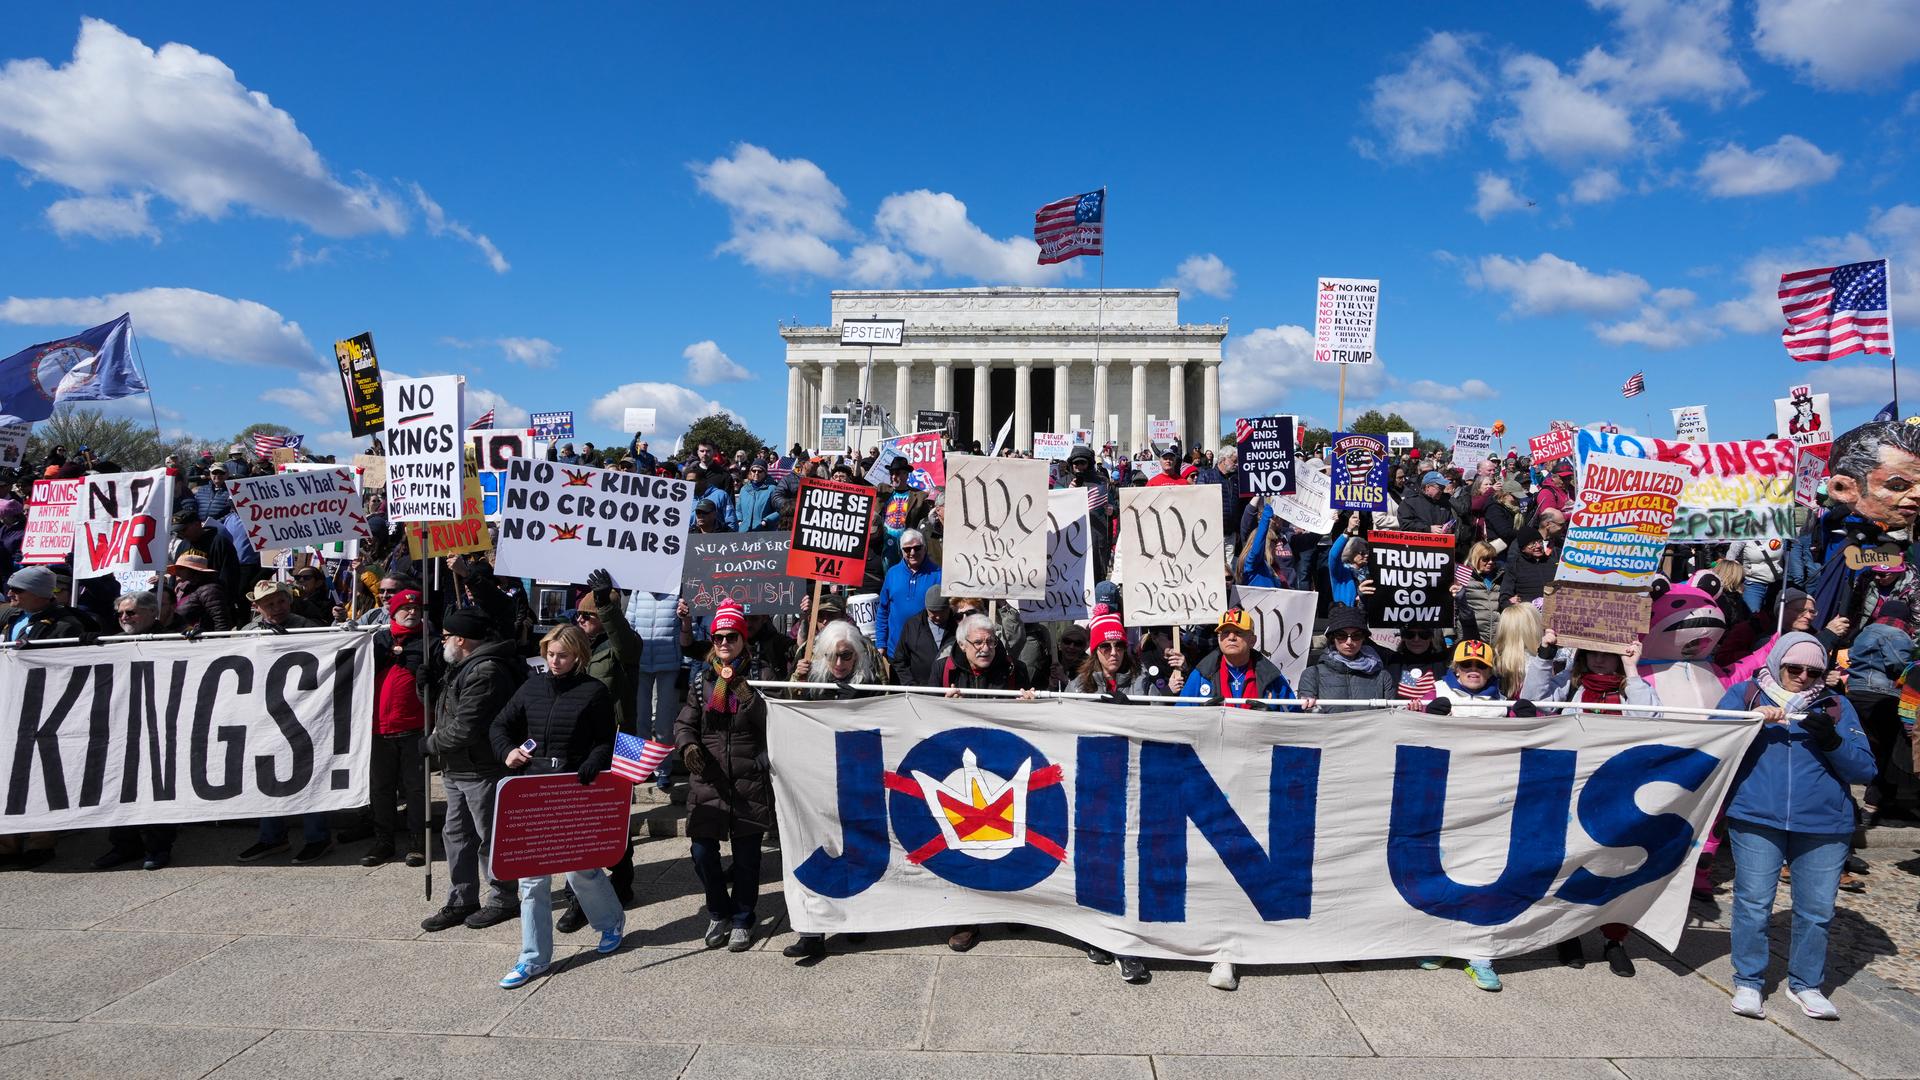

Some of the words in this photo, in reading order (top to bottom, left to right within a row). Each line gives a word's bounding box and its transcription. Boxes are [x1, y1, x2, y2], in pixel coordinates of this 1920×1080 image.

[1339, 284, 1353, 292] NO
[1354, 285, 1377, 293] KING
[1336, 294, 1375, 302] DICTATOR
[1336, 302, 1375, 310] TYRANT
[1335, 310, 1374, 318] FASCIST
[1335, 318, 1374, 326] RACIST
[843, 326, 901, 340] EPSTEIN?
[1316, 350, 1331, 362] NO
[1332, 350, 1372, 363] TRUMP
[399, 384, 434, 413] NO
[533, 415, 571, 425] RESIST!
[1262, 419, 1278, 428] ALL
[1253, 430, 1277, 439] ENDS
[1459, 426, 1471, 434] HEY
[1818, 431, 1830, 442] YOU
[388, 424, 454, 456] KINGS
[1251, 441, 1280, 449] WHEN
[1341, 437, 1380, 451] REJECTING
[1532, 432, 1560, 448] TEAR
[1246, 451, 1286, 460] ENOUGH
[1654, 438, 1797, 479] KINGS
[1808, 459, 1818, 470] NO
[390, 464, 405, 479] NO
[406, 462, 456, 481] TRUMP
[1243, 463, 1256, 471] OF
[1258, 462, 1270, 470] US
[1272, 460, 1290, 469] SAY
[247, 482, 280, 501] This
[280, 479, 295, 496] Is
[298, 473, 336, 495] What
[511, 460, 554, 484] NO
[601, 472, 687, 502] KINGS
[809, 480, 866, 493] RefuseFascism.org
[1250, 471, 1286, 492] NO
[1584, 463, 1683, 496] RADICALIZED
[32, 484, 48, 502] NO
[48, 484, 78, 501] KINGS
[89, 477, 154, 520] NO
[392, 483, 406, 499] NO
[410, 482, 451, 499] PUTIN
[1335, 485, 1383, 502] KINGS
[250, 498, 348, 521] Democracy
[389, 501, 401, 517] NO
[403, 501, 456, 518] KHAMENEI
[507, 488, 549, 511] NO
[557, 493, 681, 527] CROOKS
[804, 489, 844, 510] ¡QUE
[847, 495, 869, 514] SE
[950, 463, 1043, 541] We
[1588, 495, 1673, 514] CRITICAL
[39, 506, 70, 517] ANYTIME
[1579, 509, 1672, 527] THINKING
[27, 521, 59, 533] VIOLATORS
[61, 521, 74, 533] WILL
[270, 520, 309, 541] Looks
[313, 517, 343, 536] Like
[800, 508, 866, 534] LARGUE
[1124, 493, 1219, 566] We
[1639, 523, 1662, 533] and
[26, 536, 36, 548] BE
[40, 535, 71, 548] REMOVED
[84, 514, 157, 572] WAR
[412, 517, 482, 551] TRUMP
[503, 518, 545, 541] NO
[587, 526, 680, 555] LIARS
[802, 528, 860, 553] TRUMP
[1374, 532, 1447, 543] RefuseFascism.org
[1567, 529, 1611, 541] NORMAL
[1610, 532, 1667, 545] AMOUNTS
[981, 530, 1017, 562] the
[1594, 543, 1655, 557] HUMAN
[715, 559, 777, 573] LOADING
[815, 556, 844, 576] YA!
[1372, 548, 1449, 569] TRUMP
[1565, 550, 1656, 570] COMPASSION
[1855, 552, 1889, 564] LICKER
[949, 553, 1038, 594] People
[1160, 557, 1194, 588] the
[1380, 568, 1441, 588] MUST
[1131, 581, 1219, 620] People
[1394, 589, 1426, 605] GO
[854, 602, 880, 624] RESIS
[1383, 606, 1441, 622] NOW!
[5, 647, 356, 815] KINGS!
[794, 726, 1321, 923] JOIN
[1389, 743, 1720, 925] US
